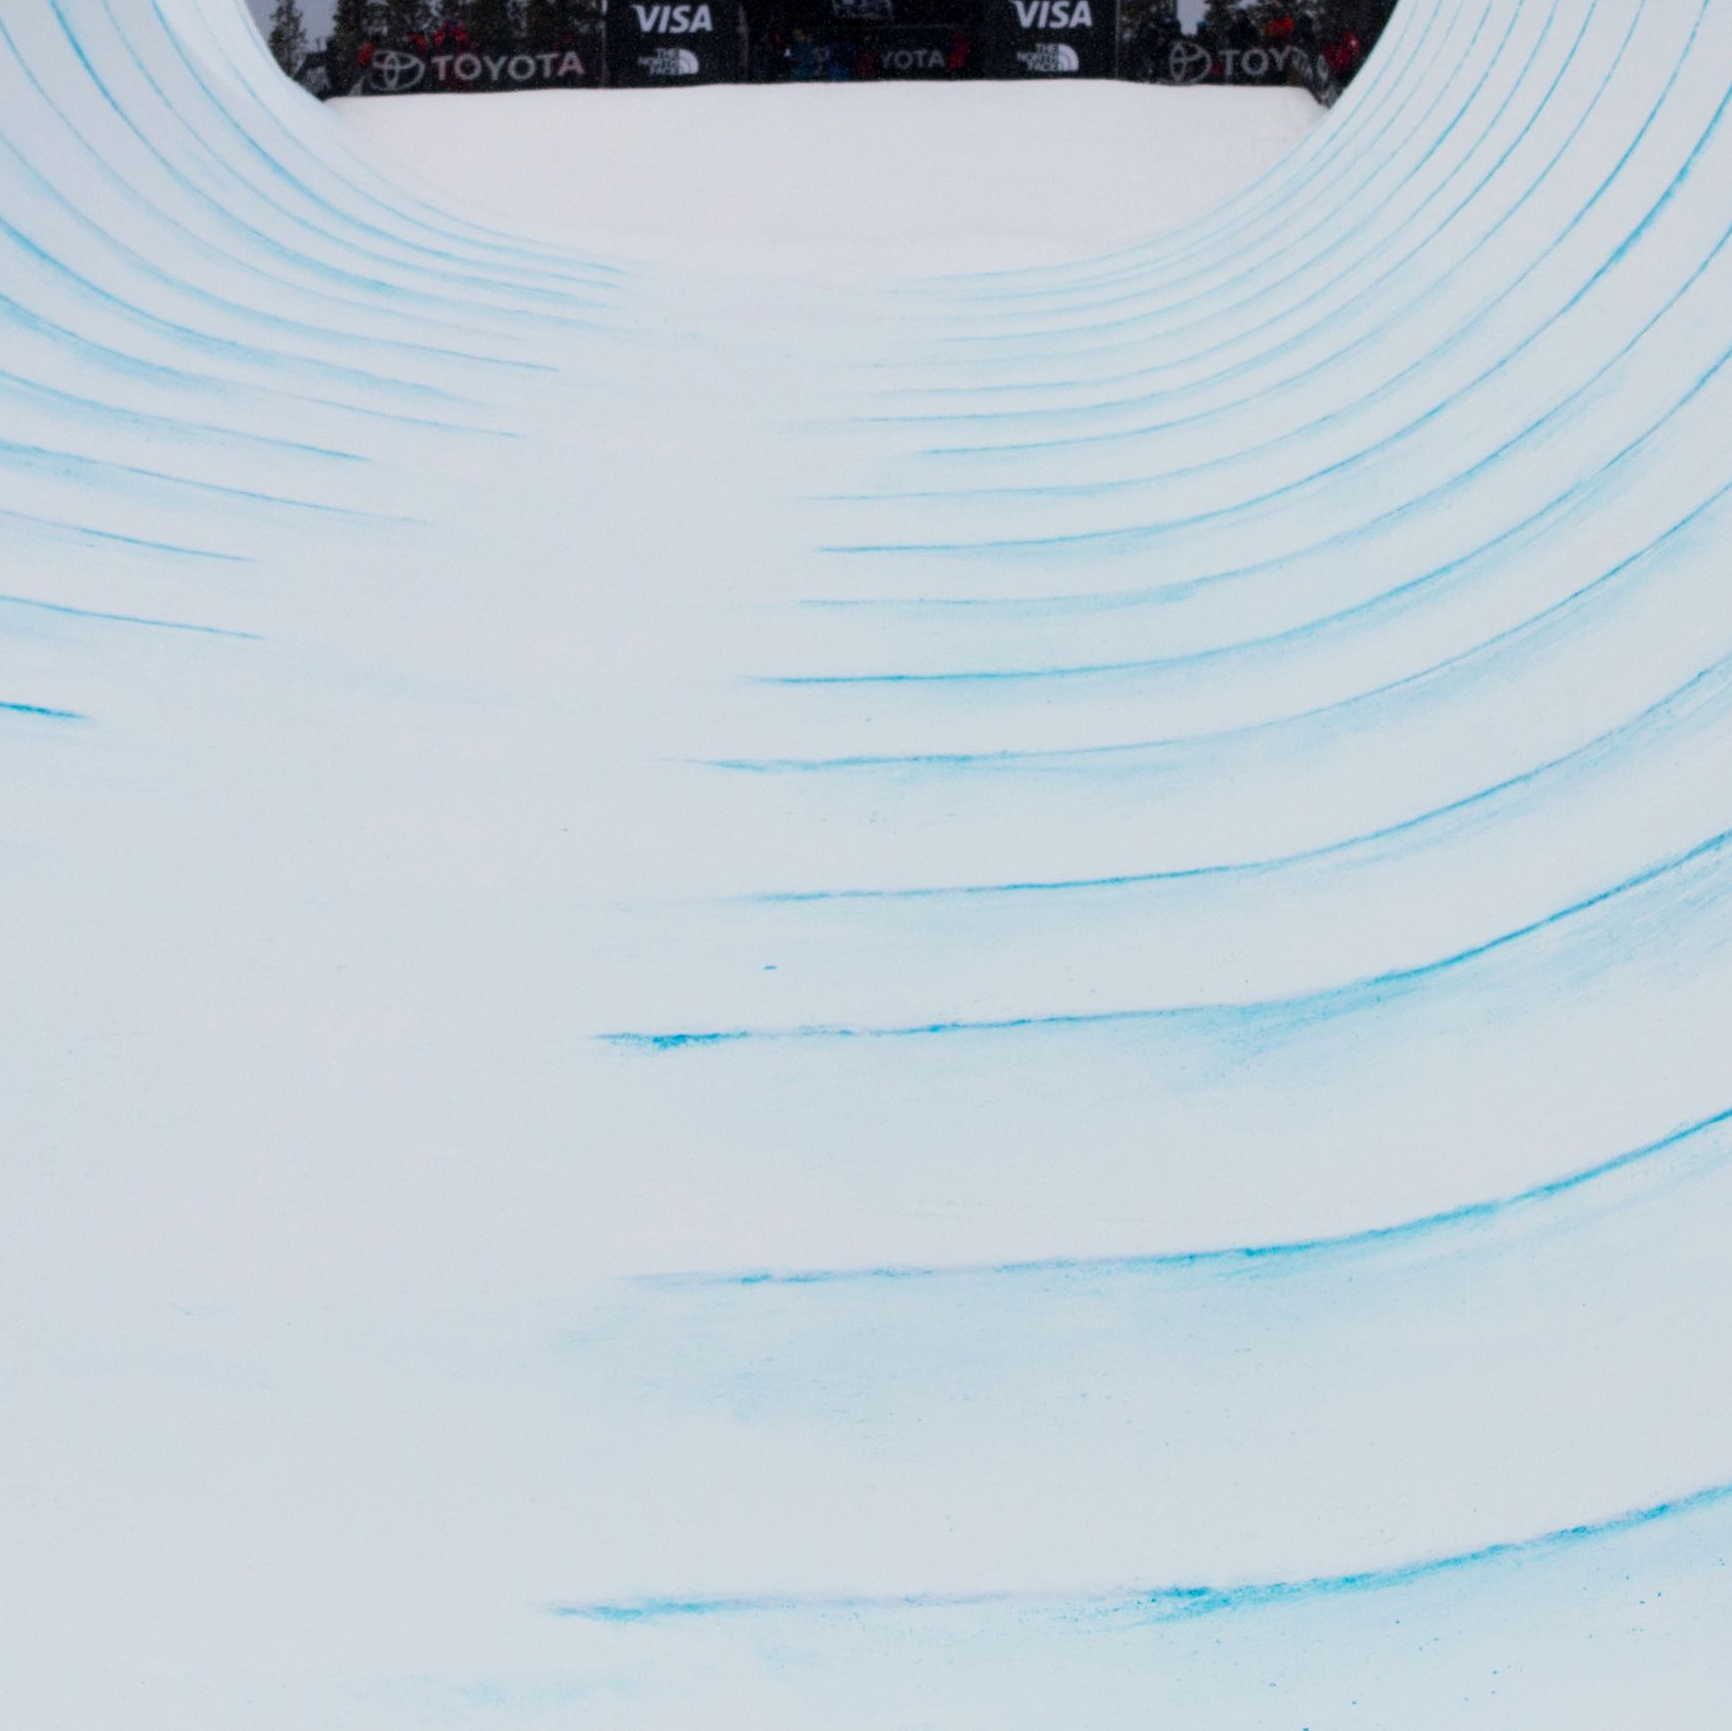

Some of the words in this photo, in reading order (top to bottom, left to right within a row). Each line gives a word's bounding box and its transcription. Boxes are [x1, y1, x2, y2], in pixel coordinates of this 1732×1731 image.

[631, 4, 713, 34] VISA
[1010, 0, 1093, 28] VISA
[431, 51, 586, 82] TOYOTA
